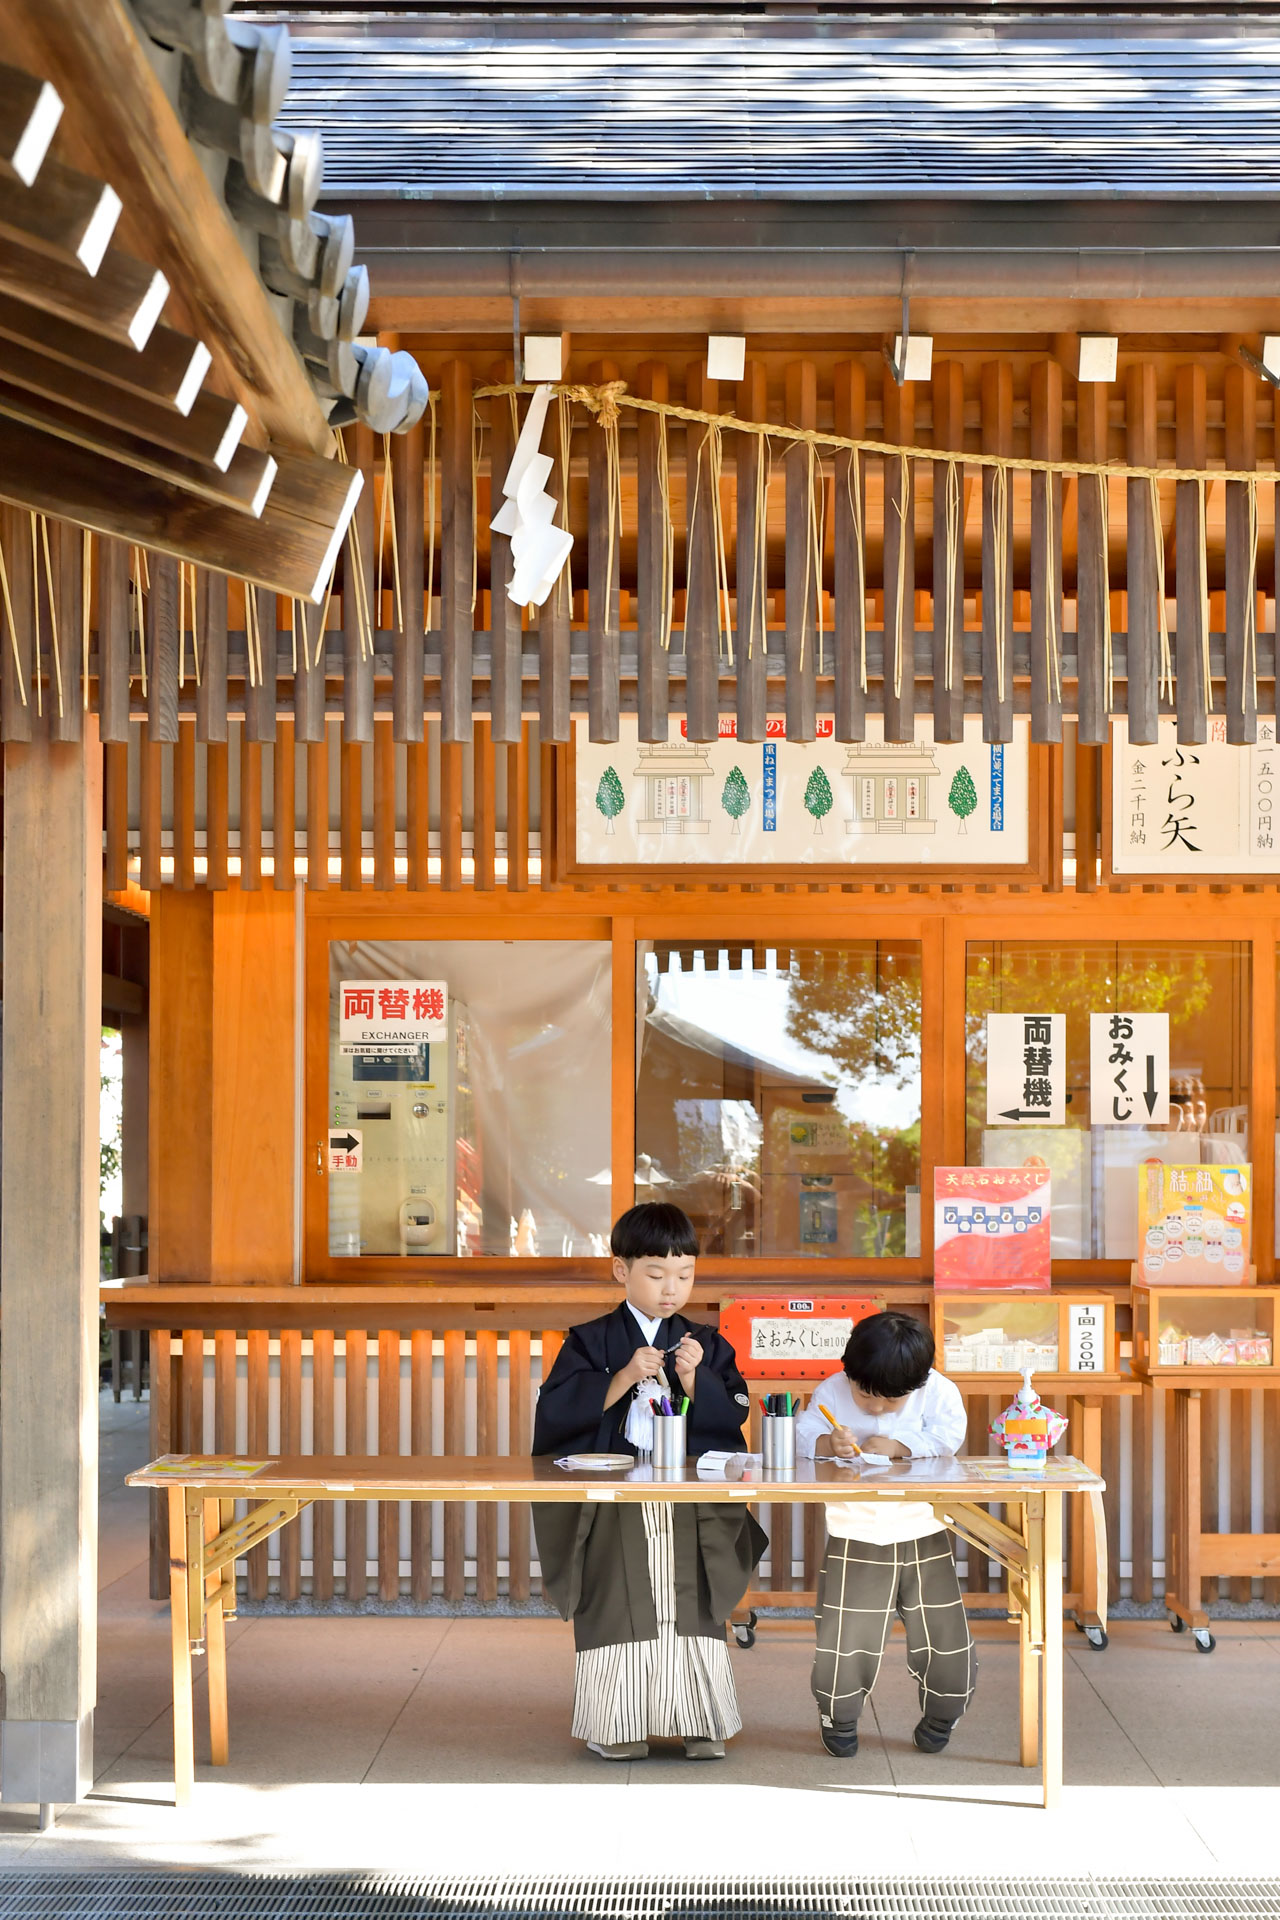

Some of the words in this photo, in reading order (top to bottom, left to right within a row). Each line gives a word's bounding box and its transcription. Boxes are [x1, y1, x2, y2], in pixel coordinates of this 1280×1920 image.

[764, 744, 775, 830] 重ねてまつる場合
[1129, 759, 1147, 845] 金二千円納
[344, 988, 444, 1021] 両替機
[361, 1031, 429, 1040] EXCHANGER
[1023, 1016, 1052, 1107] 両替機
[1108, 1015, 1134, 1121] おみくじ
[332, 1155, 358, 1167] 手動
[945, 1173, 1045, 1186] 天然石おみくじ
